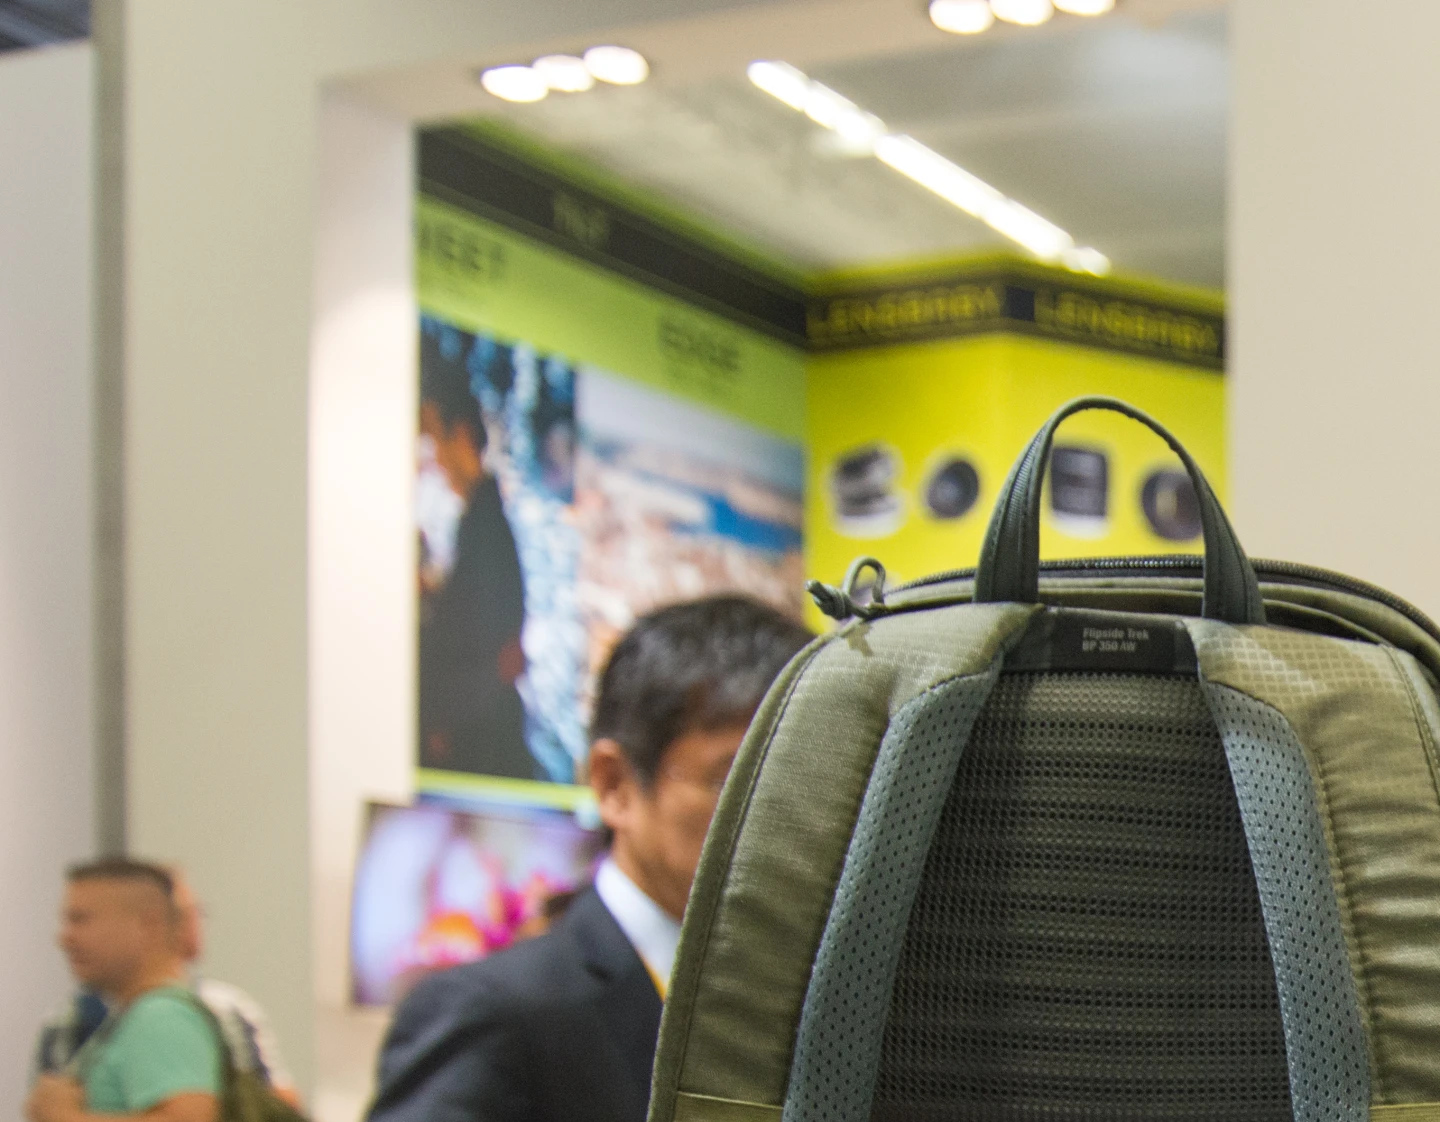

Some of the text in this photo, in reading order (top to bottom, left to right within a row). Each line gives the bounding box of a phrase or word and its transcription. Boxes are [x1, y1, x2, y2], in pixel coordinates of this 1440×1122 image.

[1082, 627, 1149, 640] Flipside Trek
[1119, 641, 1136, 652] AW
